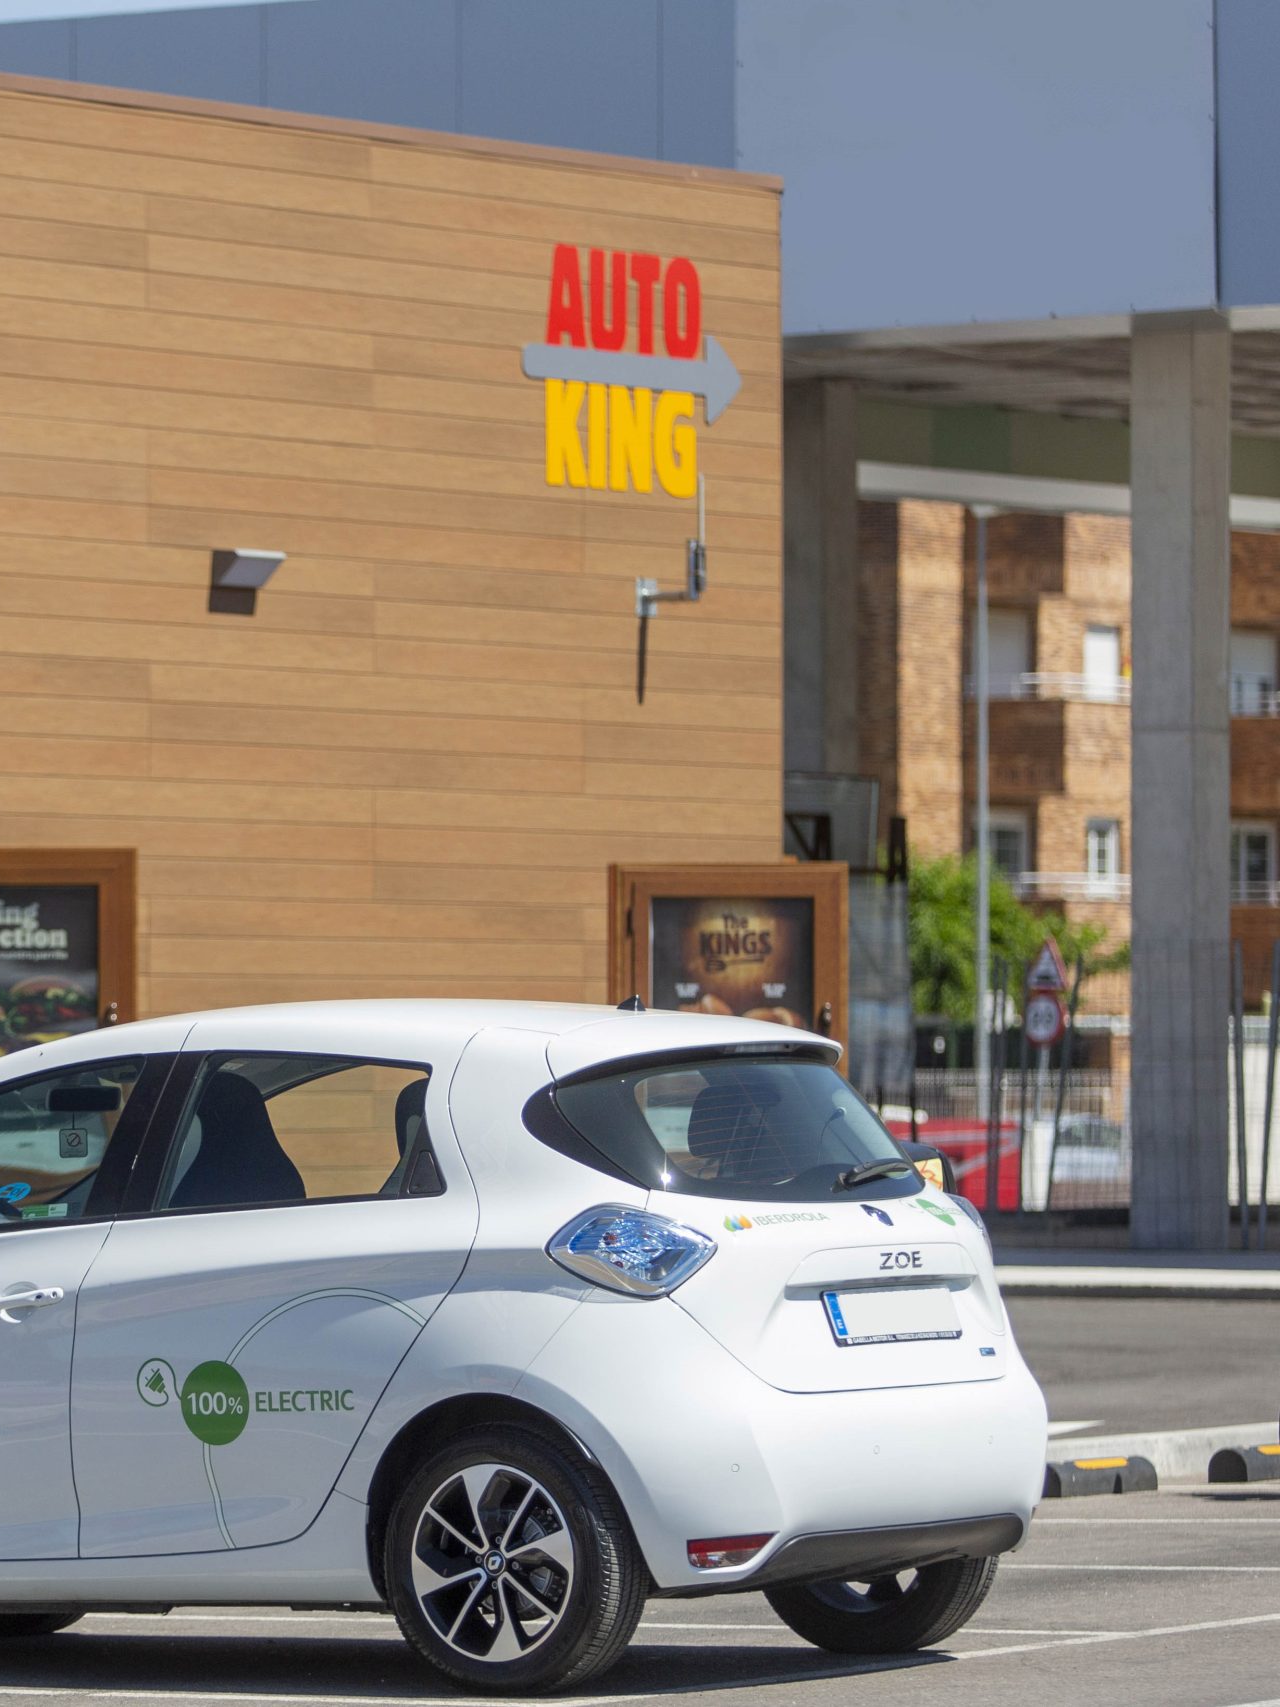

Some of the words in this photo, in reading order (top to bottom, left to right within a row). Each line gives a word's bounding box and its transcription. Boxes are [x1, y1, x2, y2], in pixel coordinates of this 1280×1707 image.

[545, 242, 702, 360] AUTO
[544, 377, 697, 499] KING
[722, 912, 748, 930] The
[699, 931, 772, 957] KINGS
[752, 1211, 829, 1227] IBERDROLA
[879, 1250, 923, 1270] ZOE
[187, 1391, 243, 1416] 100%
[255, 1389, 355, 1413] ELECTRIC
